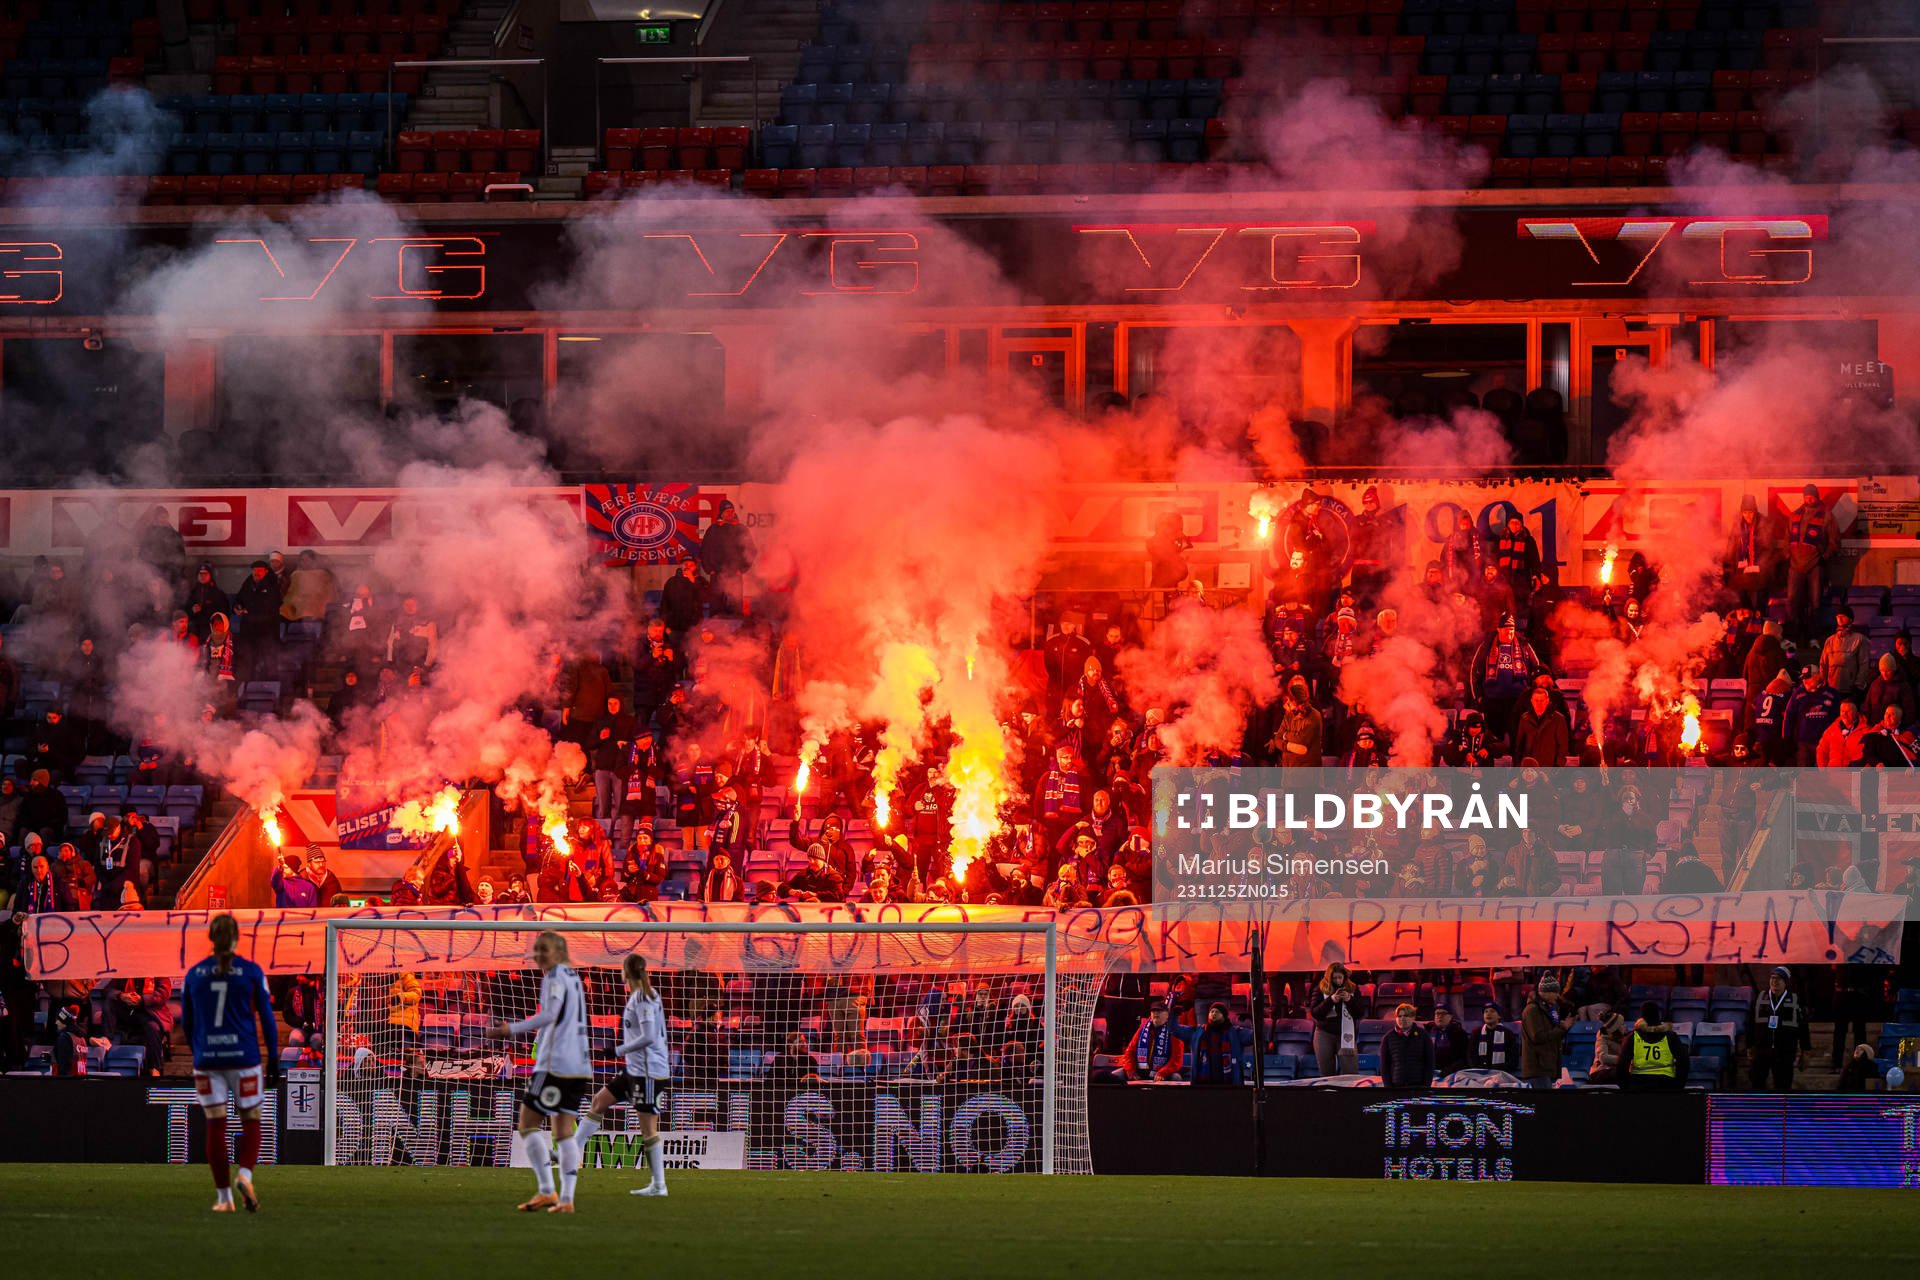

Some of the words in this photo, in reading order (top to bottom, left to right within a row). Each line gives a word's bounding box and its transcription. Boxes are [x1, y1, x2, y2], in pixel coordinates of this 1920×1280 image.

[1079, 226, 1361, 290] VG
[1525, 221, 1813, 285] VG
[1840, 361, 1886, 375] MEET
[1761, 696, 1773, 717] 9
[338, 811, 379, 837] ELISE
[35, 912, 141, 976] BY
[166, 910, 317, 973] THE
[602, 904, 707, 968] OF
[210, 981, 227, 1028] 7
[1643, 1046, 1661, 1060] 76
[1363, 1096, 1536, 1149] THON
[663, 1135, 707, 1155] mini
[1384, 1155, 1514, 1182] HOTELS
